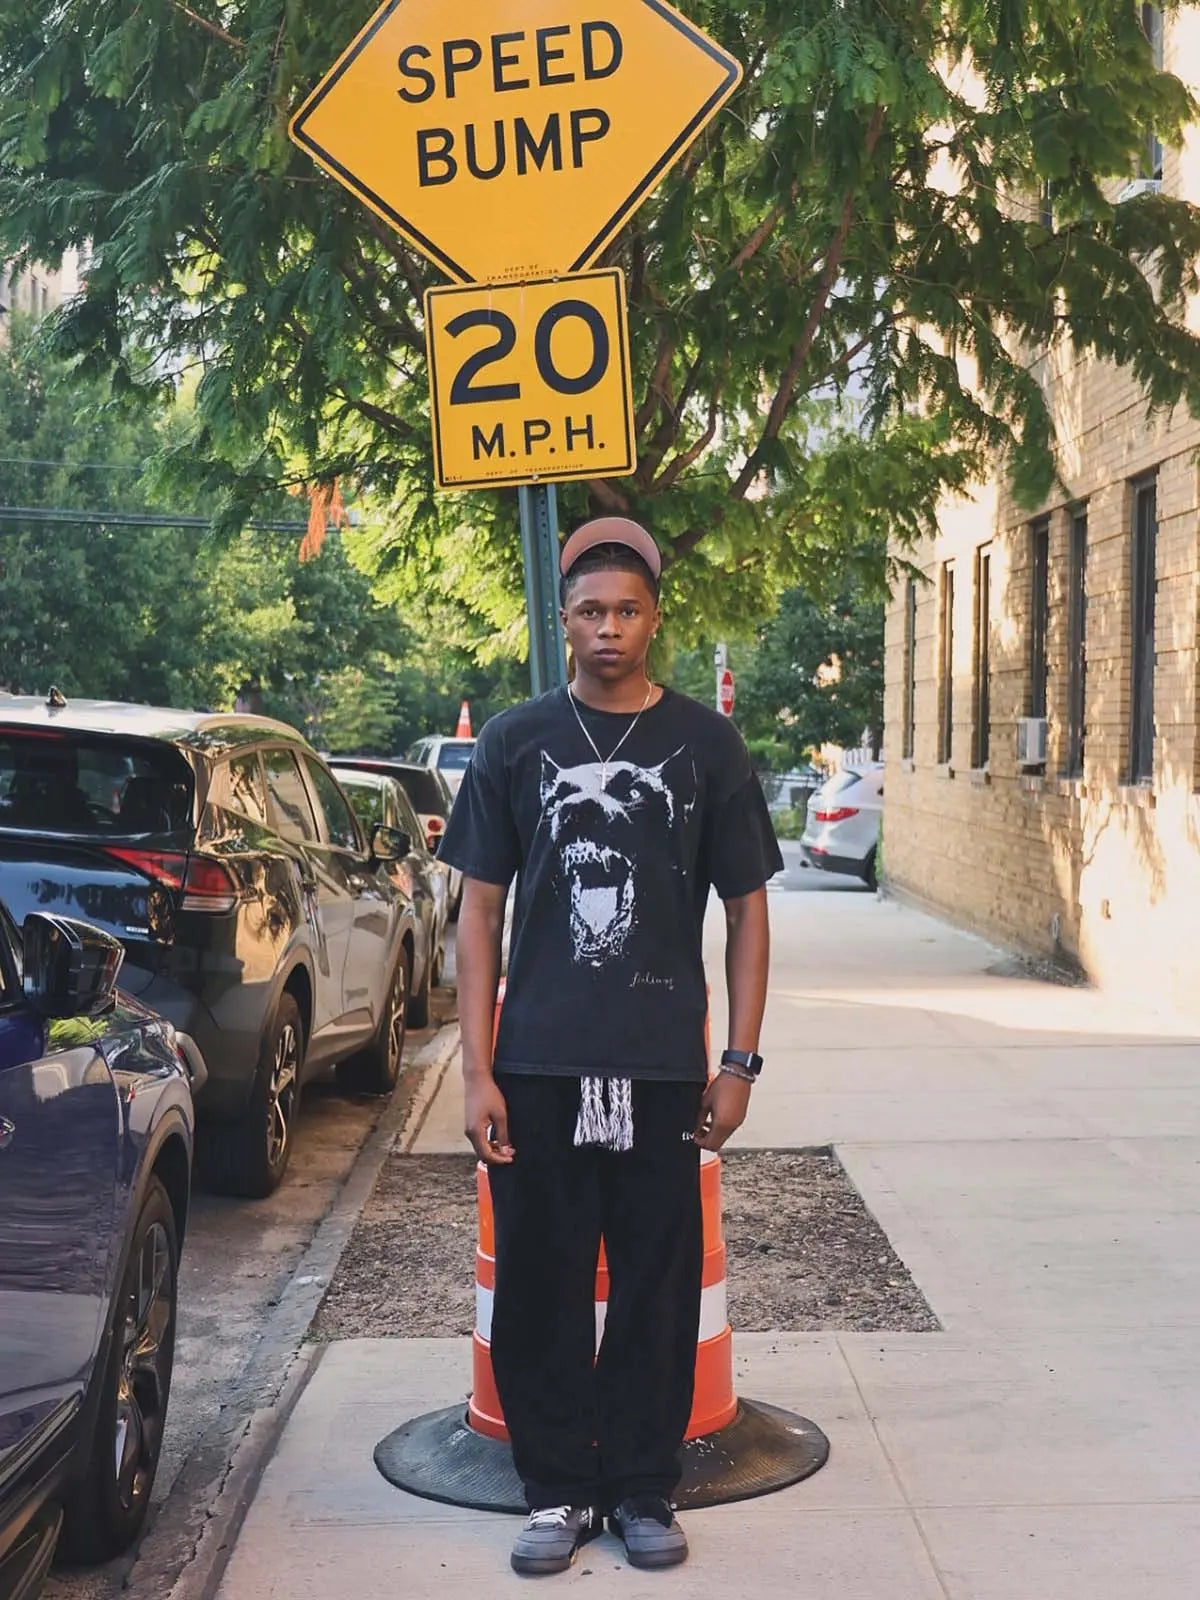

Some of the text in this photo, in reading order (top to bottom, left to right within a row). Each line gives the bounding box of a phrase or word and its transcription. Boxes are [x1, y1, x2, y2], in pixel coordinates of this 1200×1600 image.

[397, 20, 623, 103] SPEED
[416, 108, 610, 187] BUMP
[487, 269, 559, 280] TRANSPORTATION
[444, 299, 609, 405] 20
[471, 414, 605, 460] M.P.H.
